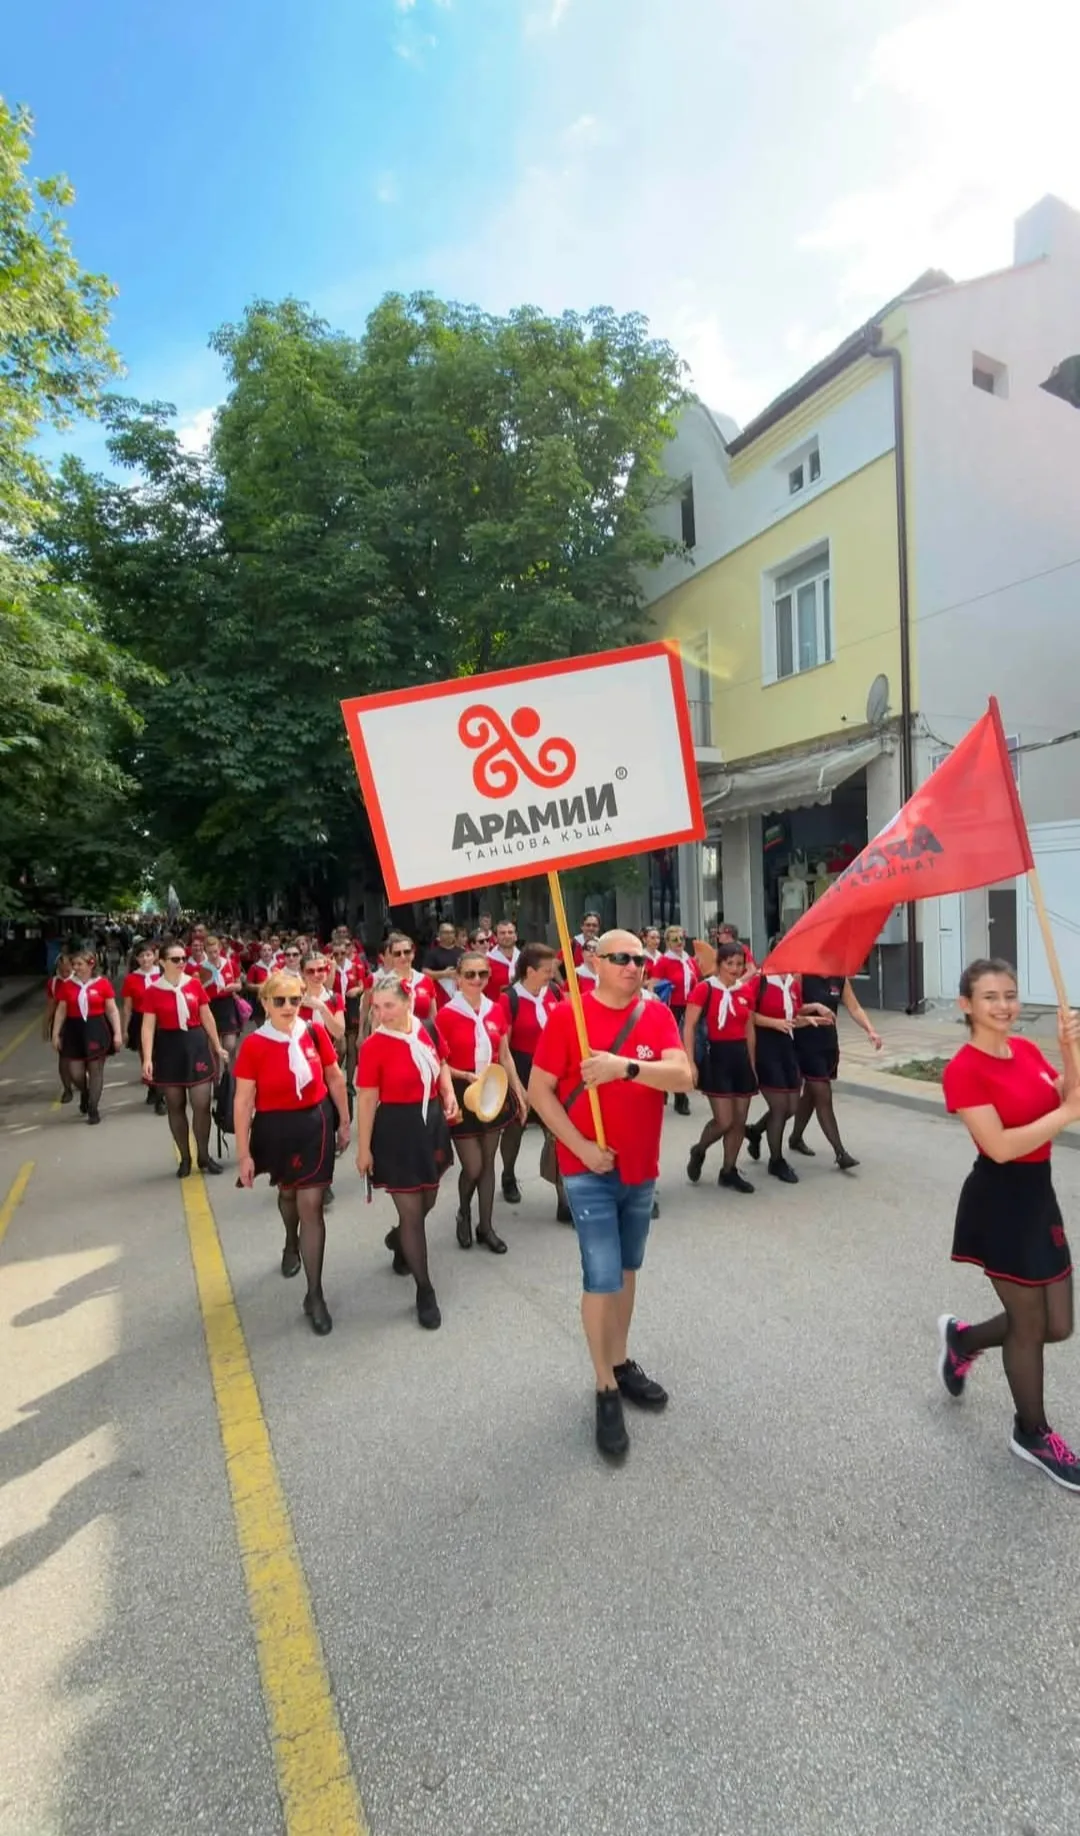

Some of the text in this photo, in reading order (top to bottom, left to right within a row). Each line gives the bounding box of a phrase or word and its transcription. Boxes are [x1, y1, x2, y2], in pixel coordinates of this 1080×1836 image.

[451, 782, 618, 850] АРАМИИ
[465, 822, 613, 861] ТАНЦОВА КЪЩА
